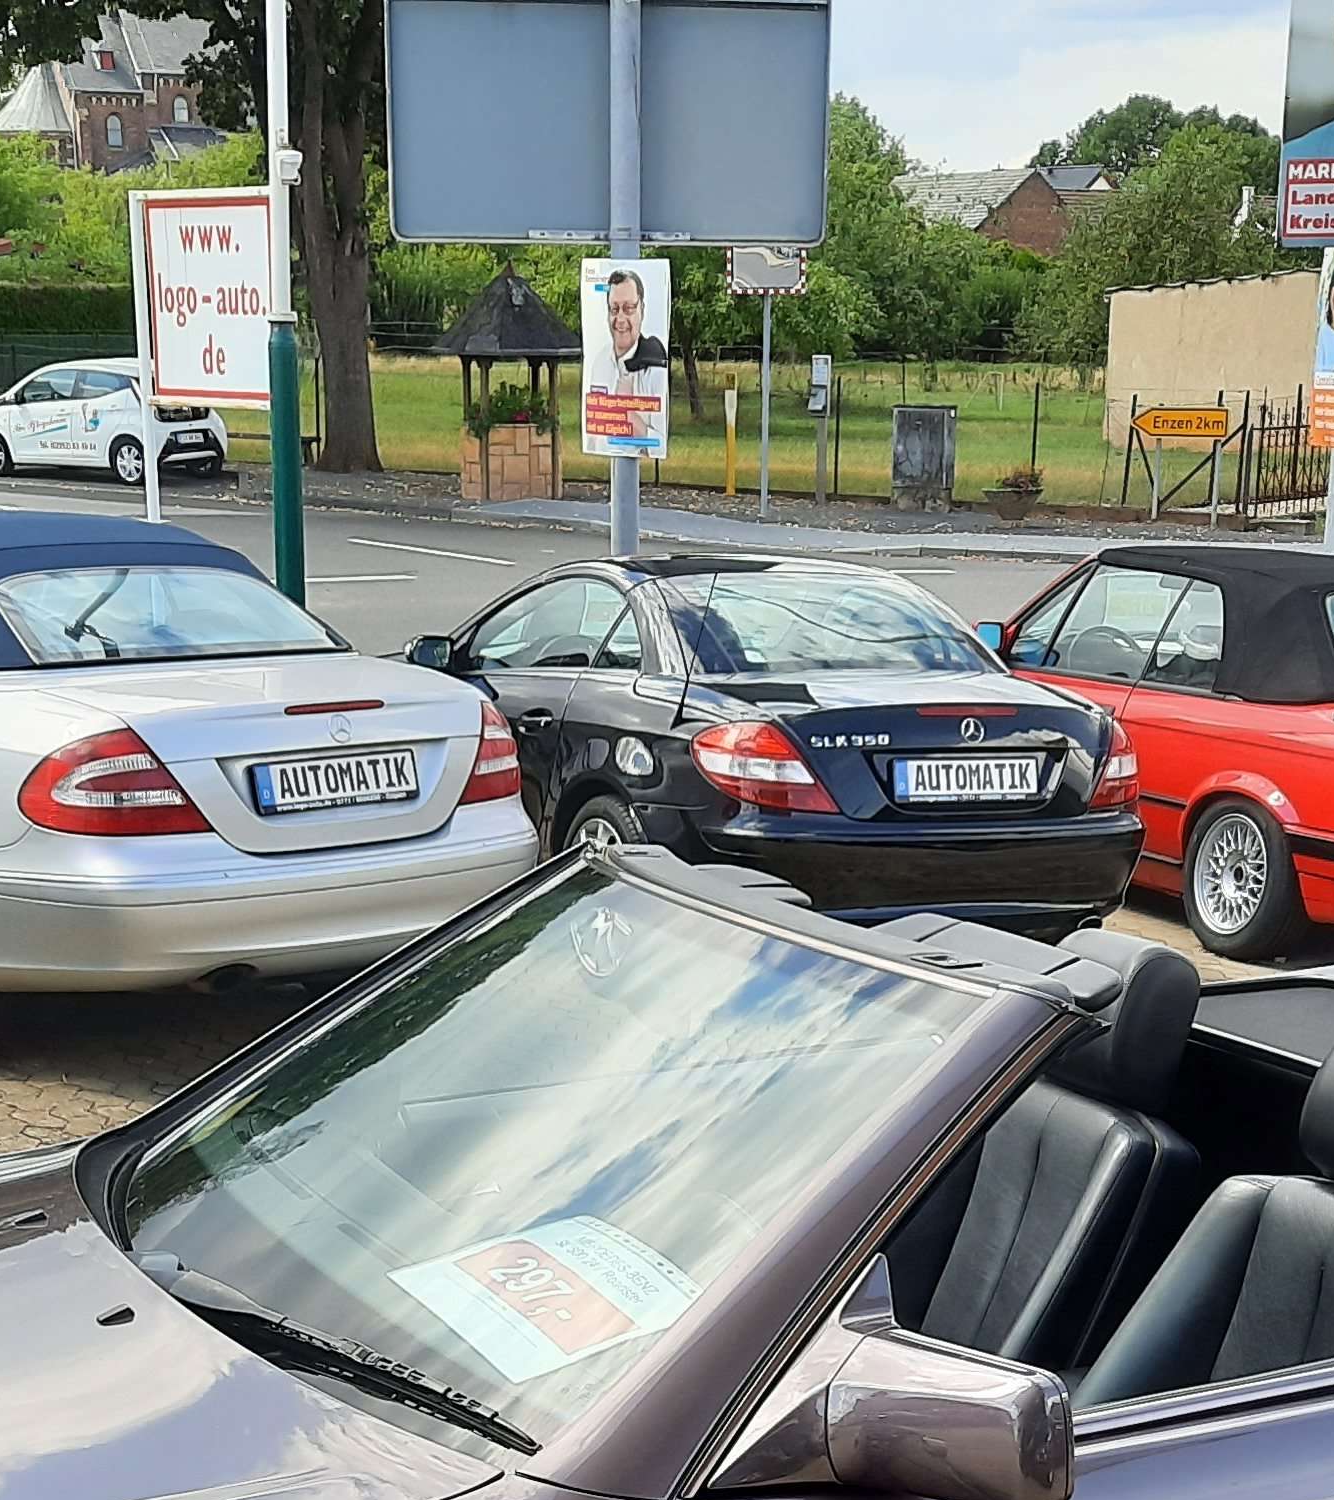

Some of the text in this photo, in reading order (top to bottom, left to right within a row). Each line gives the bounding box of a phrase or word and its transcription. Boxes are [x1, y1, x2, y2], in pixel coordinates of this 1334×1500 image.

[179, 225, 240, 253] www.
[203, 334, 226, 376] de
[1153, 416, 1193, 429] Enzen
[810, 734, 889, 748] SLK 350
[279, 755, 411, 800] AUTOMATIK
[914, 762, 1034, 792] AUTOMATIK
[487, 1256, 574, 1304] 297
